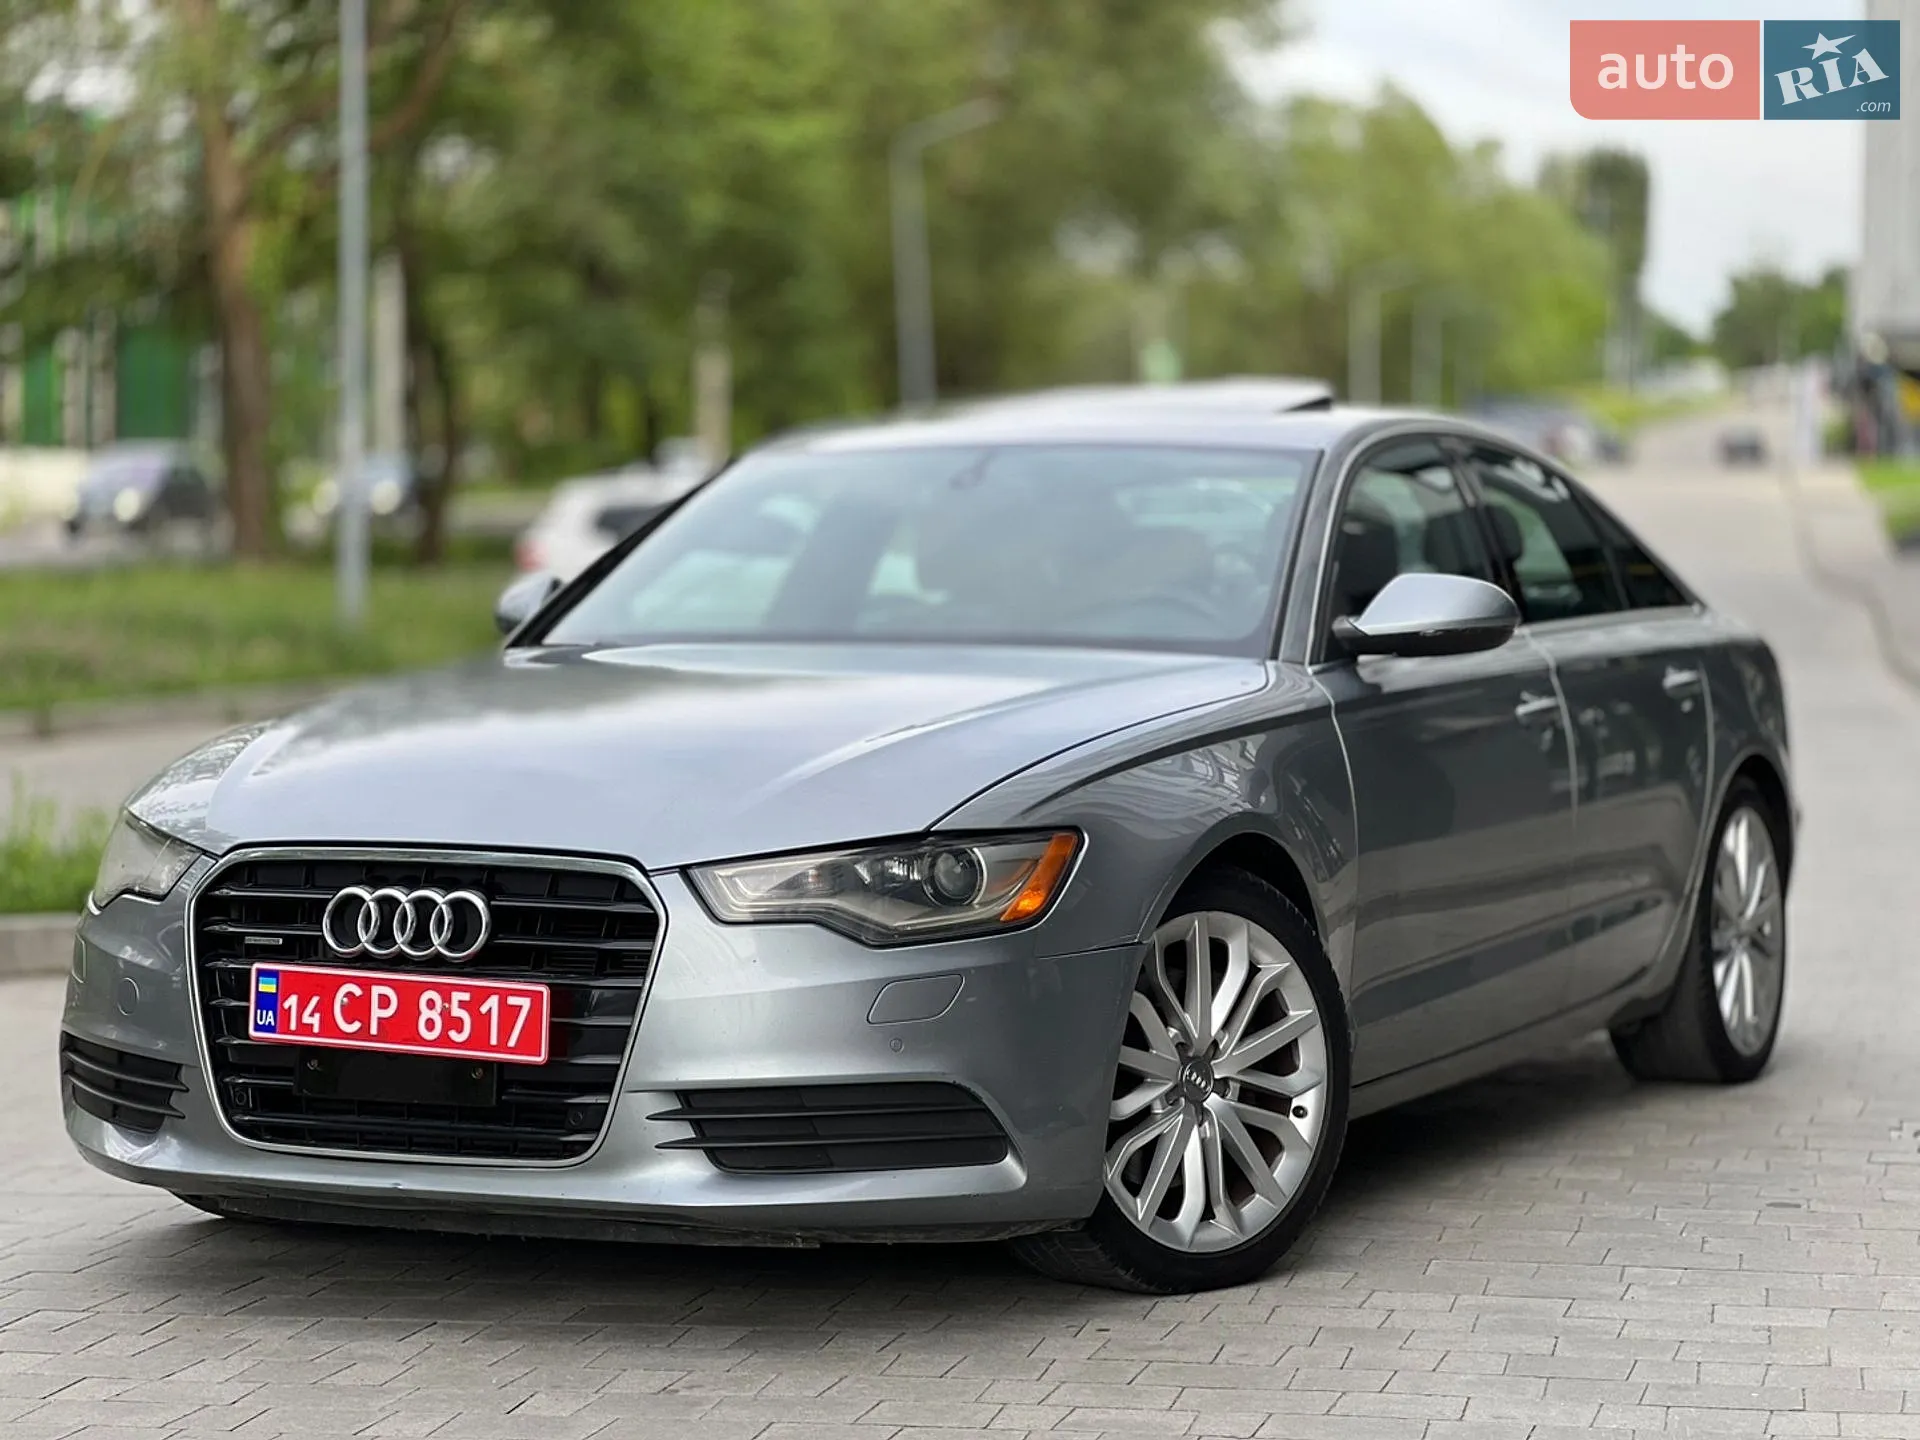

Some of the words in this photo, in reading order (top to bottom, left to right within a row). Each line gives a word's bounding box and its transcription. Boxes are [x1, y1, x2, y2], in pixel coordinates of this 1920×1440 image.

[257, 1009, 275, 1027] UA
[283, 994, 321, 1034] 14
[333, 982, 398, 1036] CP
[417, 989, 532, 1048] 8517
